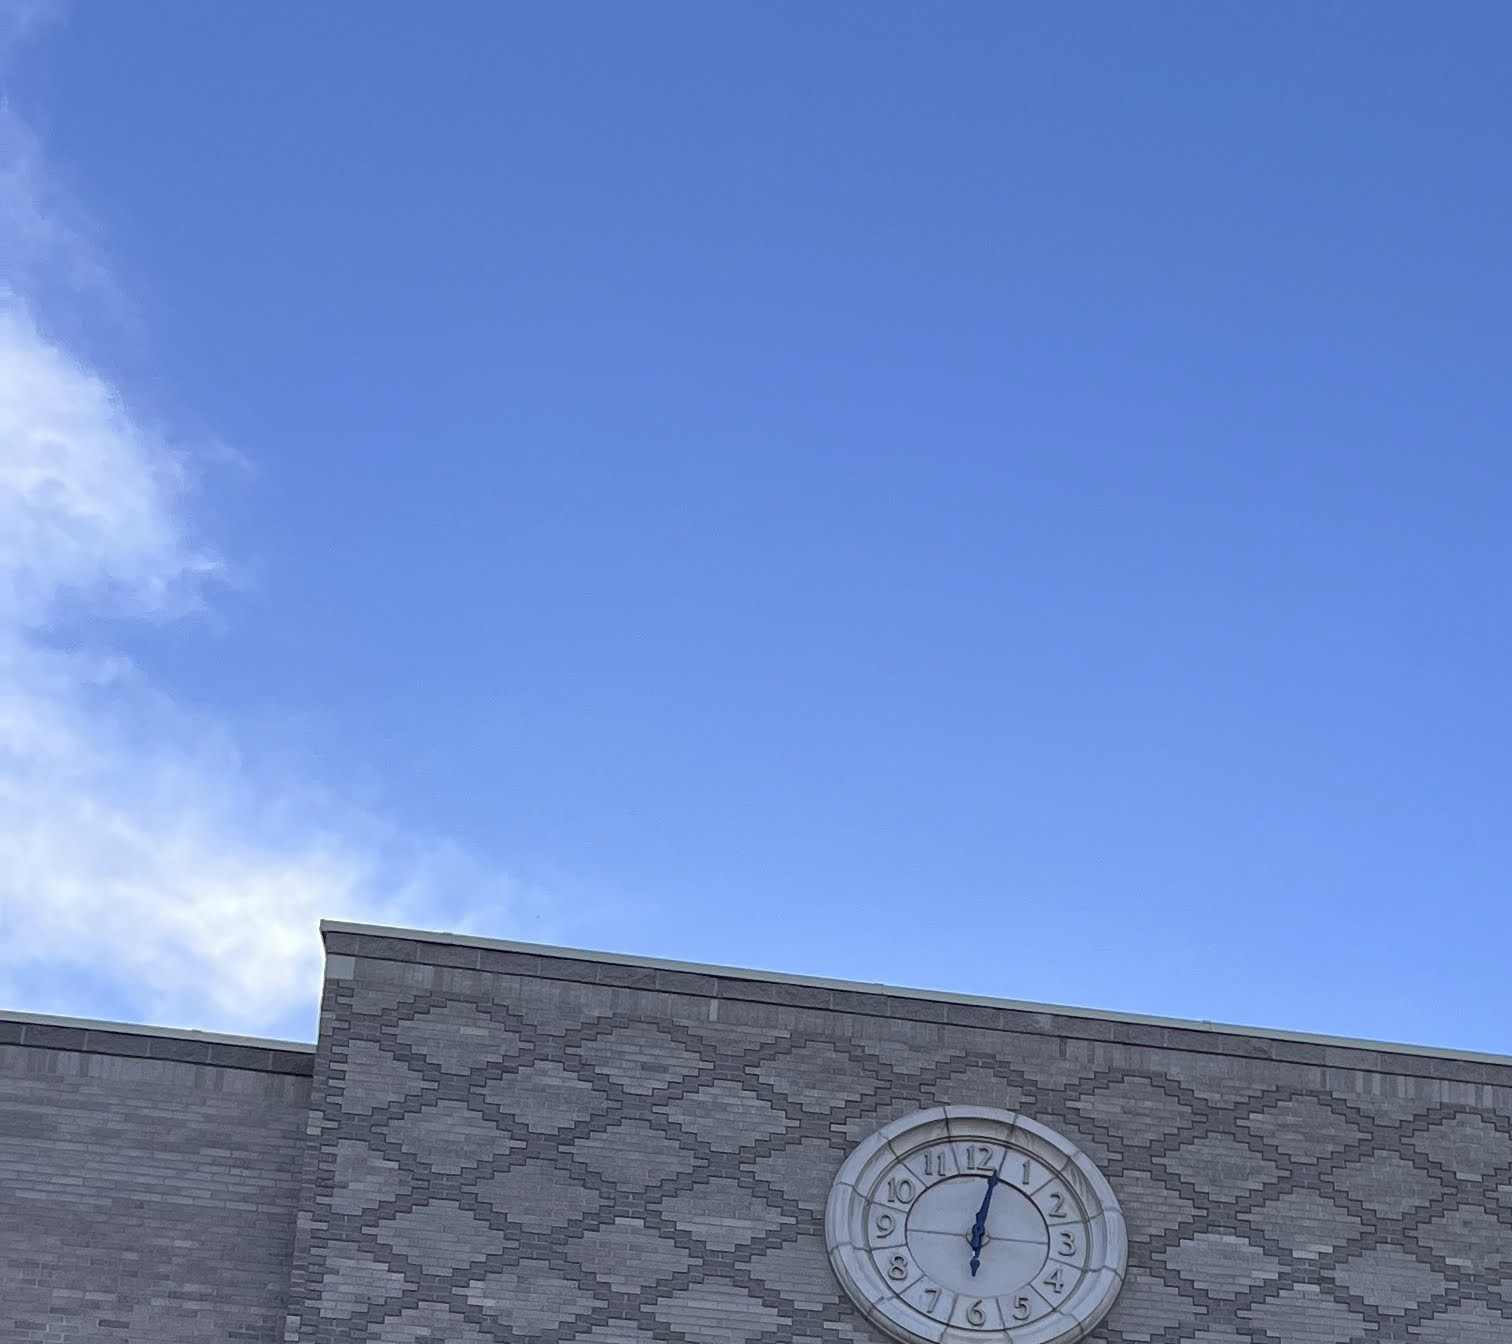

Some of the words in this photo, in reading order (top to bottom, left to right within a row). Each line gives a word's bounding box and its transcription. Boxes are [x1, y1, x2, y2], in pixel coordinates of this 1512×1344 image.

[924, 1151, 946, 1176] 11
[966, 1145, 996, 1171] 12
[1021, 1159, 1031, 1184] 1
[887, 1177, 916, 1204] 10
[1049, 1192, 1067, 1217] 2
[875, 1214, 896, 1238] 9
[1059, 1232, 1076, 1257] 3
[888, 1255, 908, 1281] 8
[1044, 1269, 1064, 1293] 4
[924, 1288, 942, 1313] 7
[966, 1300, 986, 1326] 6
[1013, 1297, 1031, 1321] 5
